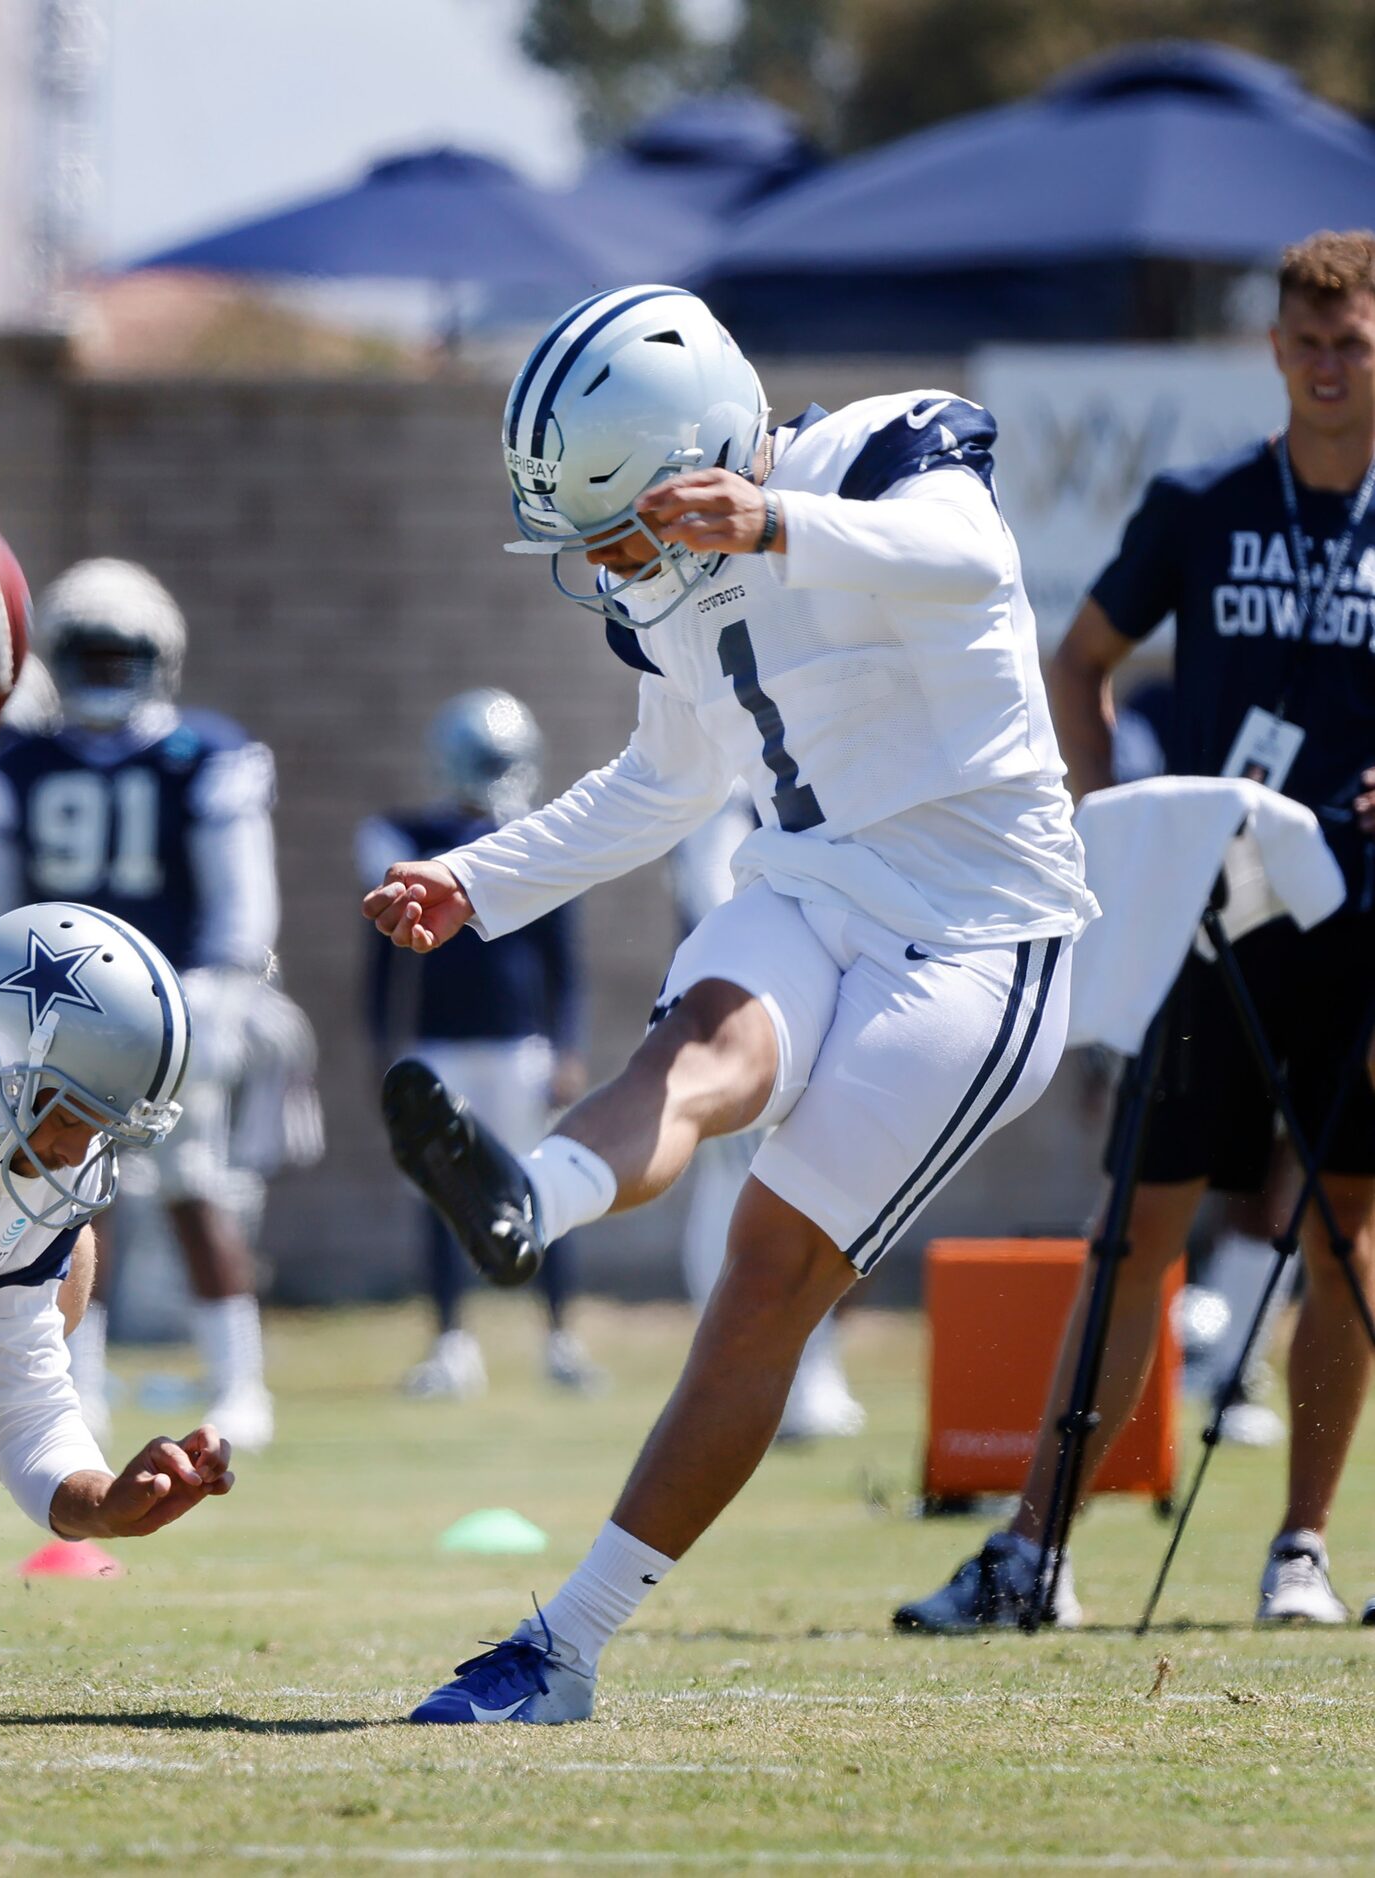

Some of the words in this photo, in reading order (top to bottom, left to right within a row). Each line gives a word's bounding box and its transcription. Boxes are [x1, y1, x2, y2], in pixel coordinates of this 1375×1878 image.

[507, 451, 558, 479] ARIBAY
[697, 584, 746, 613] COWBOYS
[717, 618, 827, 834] 1
[27, 766, 166, 897] 91
